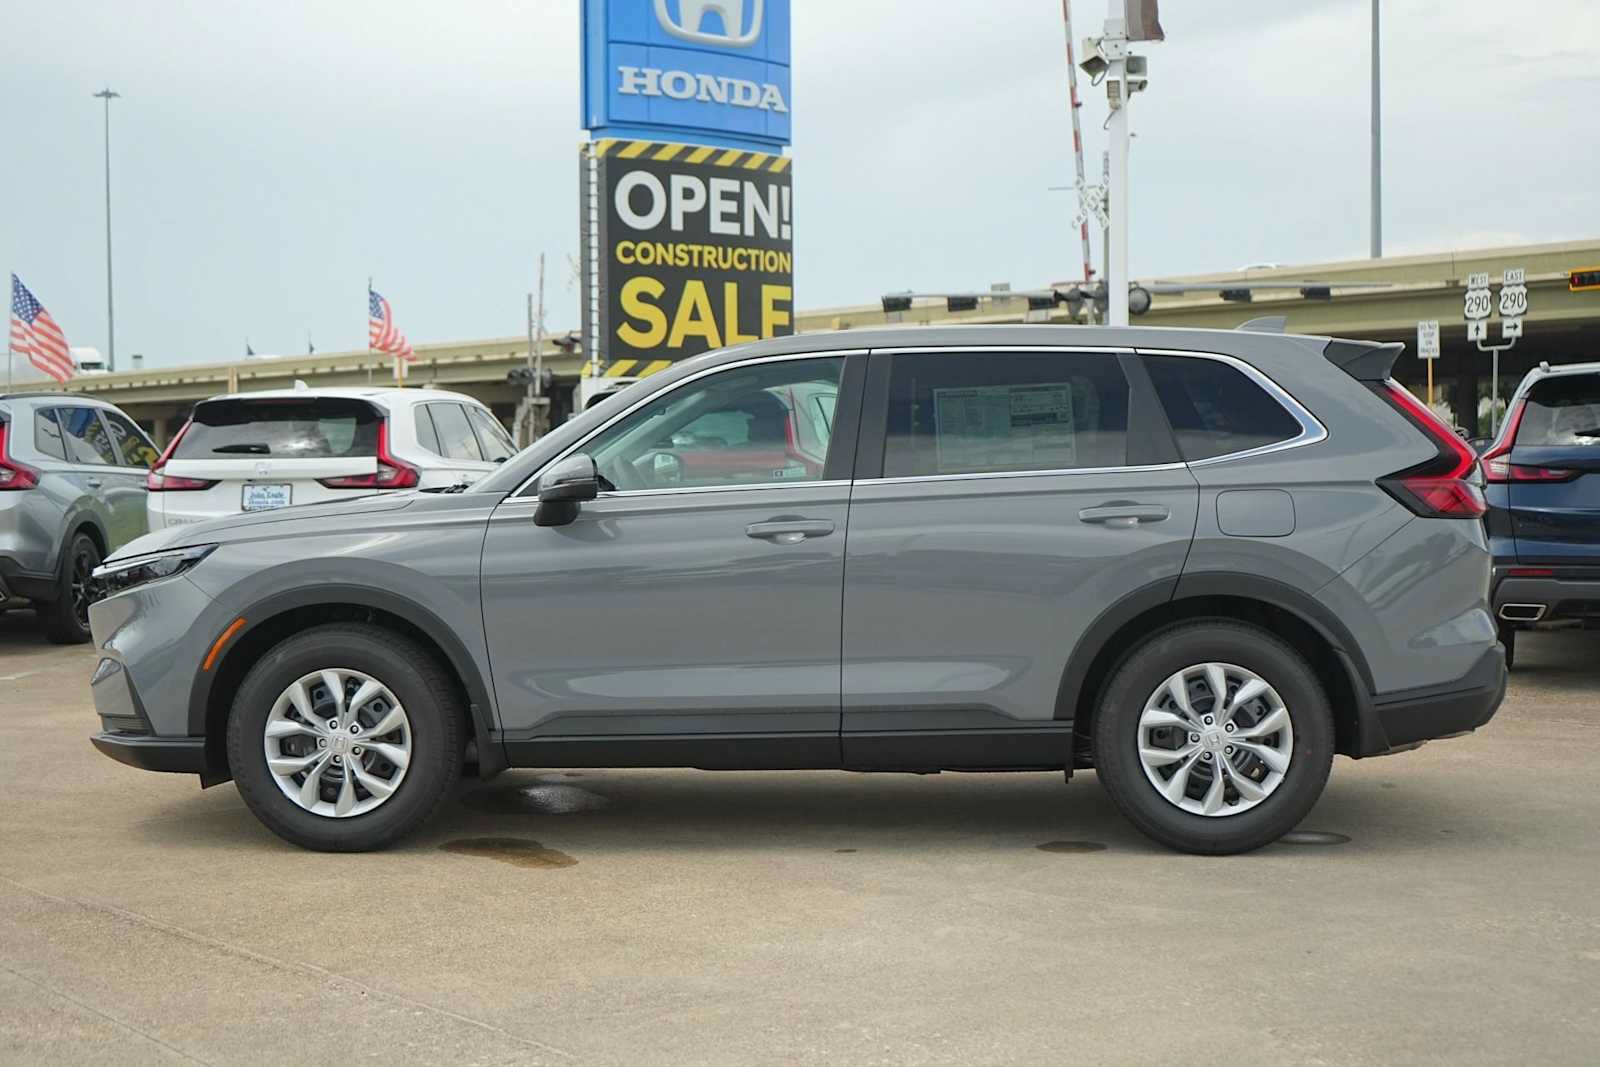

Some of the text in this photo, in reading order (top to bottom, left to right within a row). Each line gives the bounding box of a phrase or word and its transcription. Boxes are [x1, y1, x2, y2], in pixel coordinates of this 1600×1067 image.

[617, 66, 788, 113] HONDA
[614, 170, 791, 240] OPEN!
[615, 240, 791, 274] CONSTRUCTION
[1505, 271, 1523, 281] EAST
[616, 276, 792, 349] SALE
[1467, 295, 1489, 313] 290
[1502, 292, 1525, 310] 290
